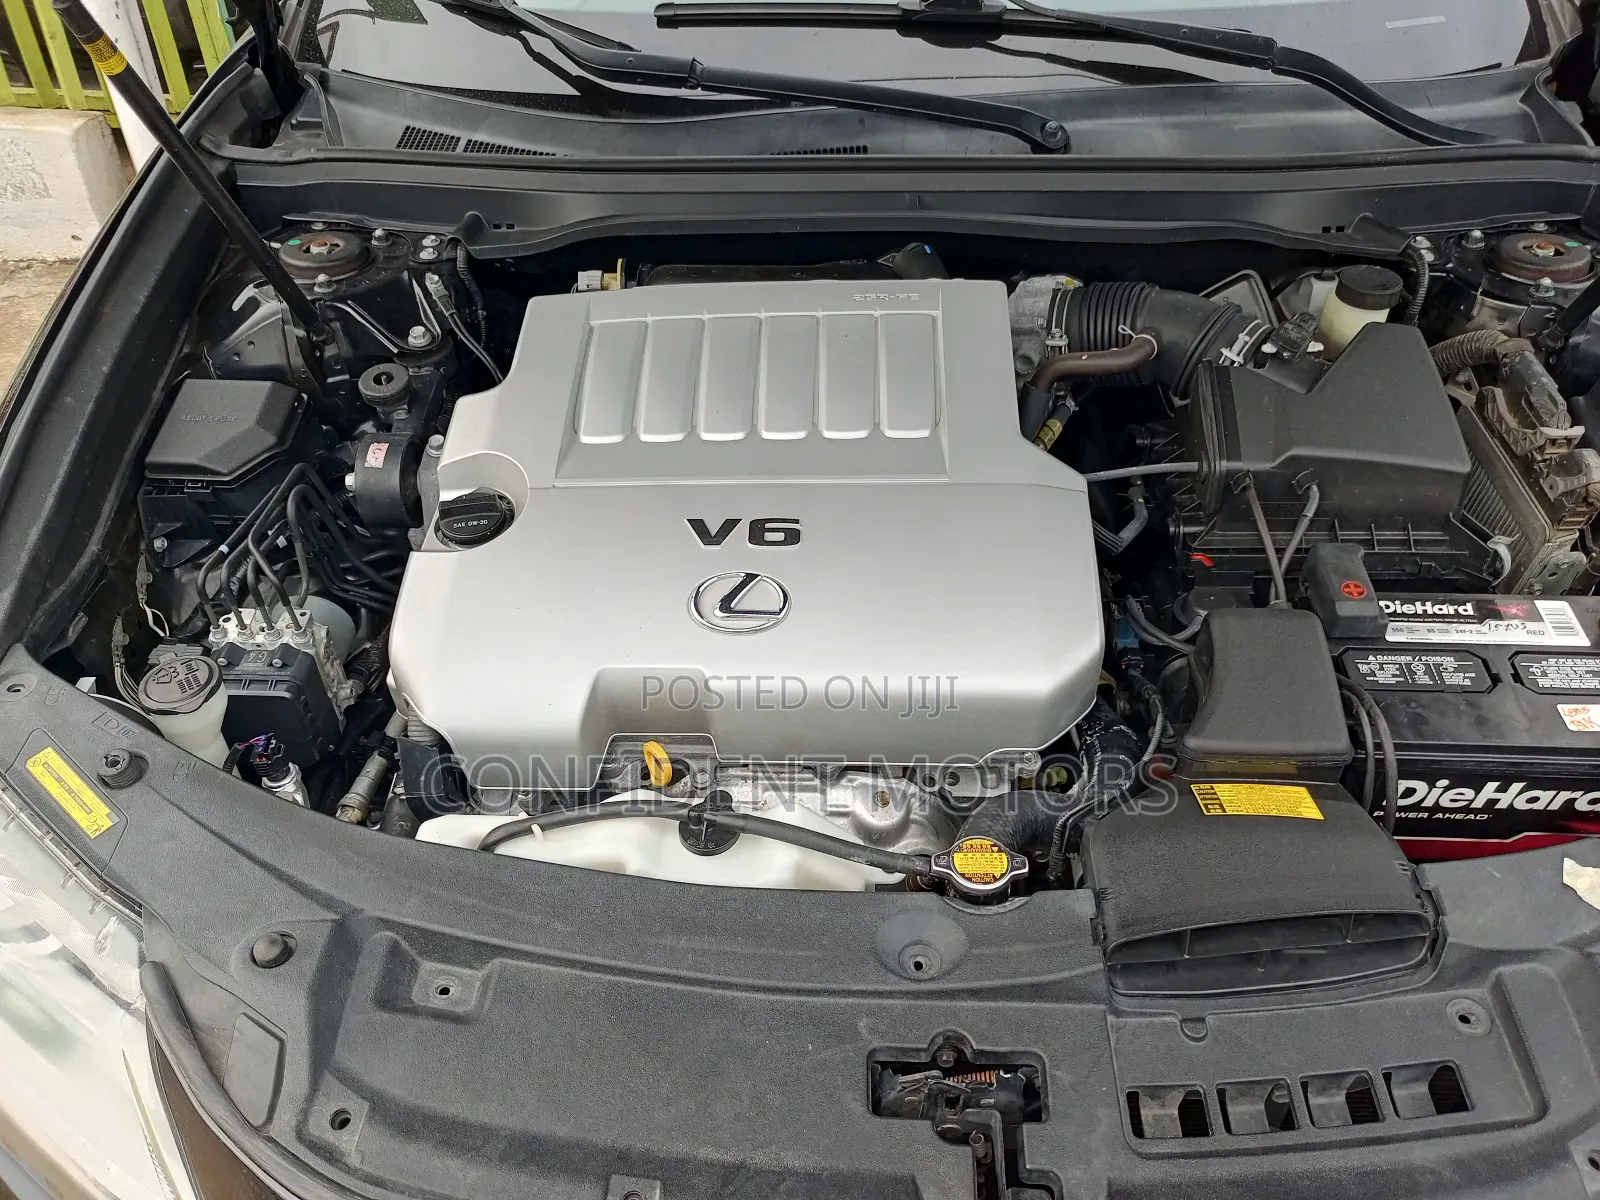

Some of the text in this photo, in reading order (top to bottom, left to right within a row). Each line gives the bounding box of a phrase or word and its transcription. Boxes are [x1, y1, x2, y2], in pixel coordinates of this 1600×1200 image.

[685, 518, 801, 549] V6
[1378, 600, 1475, 616] DieHard
[1373, 811, 1489, 820] PWER AHEAD
